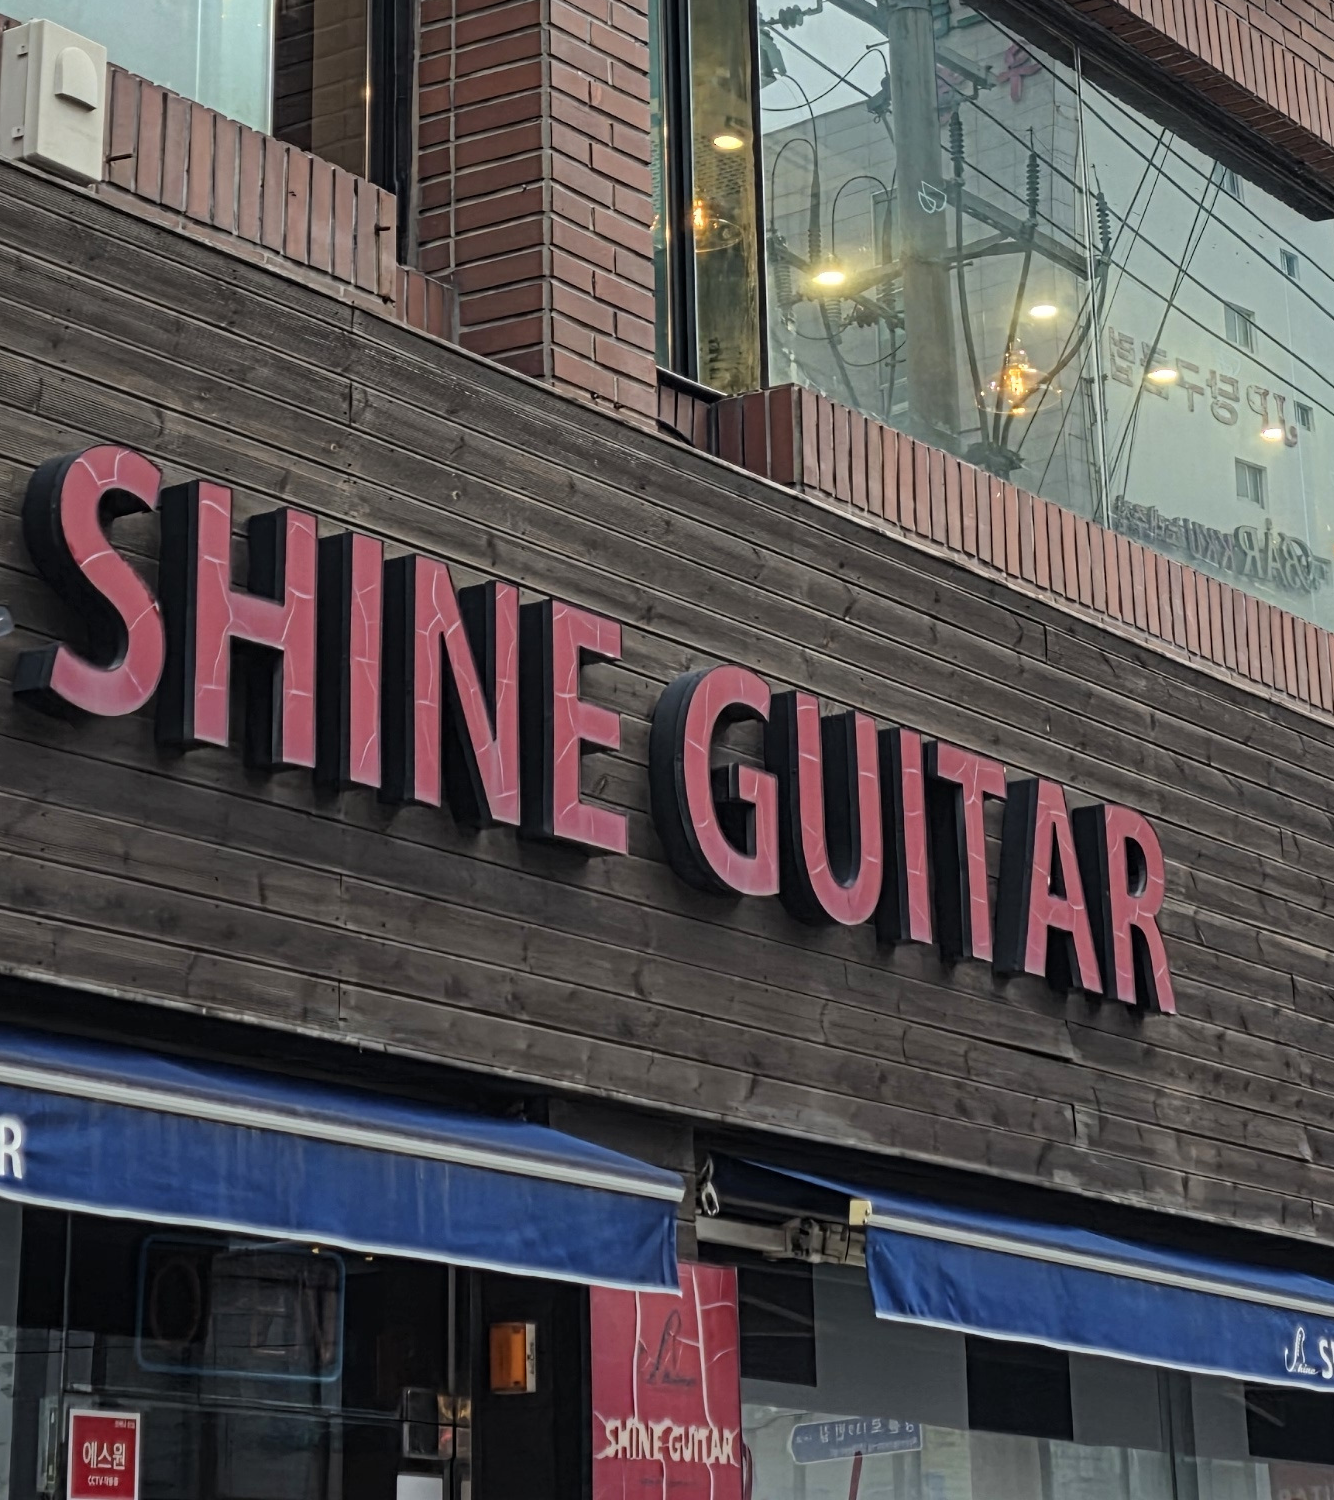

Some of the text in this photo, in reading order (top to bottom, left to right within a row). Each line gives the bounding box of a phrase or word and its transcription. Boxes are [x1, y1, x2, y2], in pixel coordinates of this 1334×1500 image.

[39, 444, 1177, 1015] SHINE GUITAR
[82, 1441, 126, 1471] 에스원
[605, 1418, 735, 1465] SHINE GUITAR
